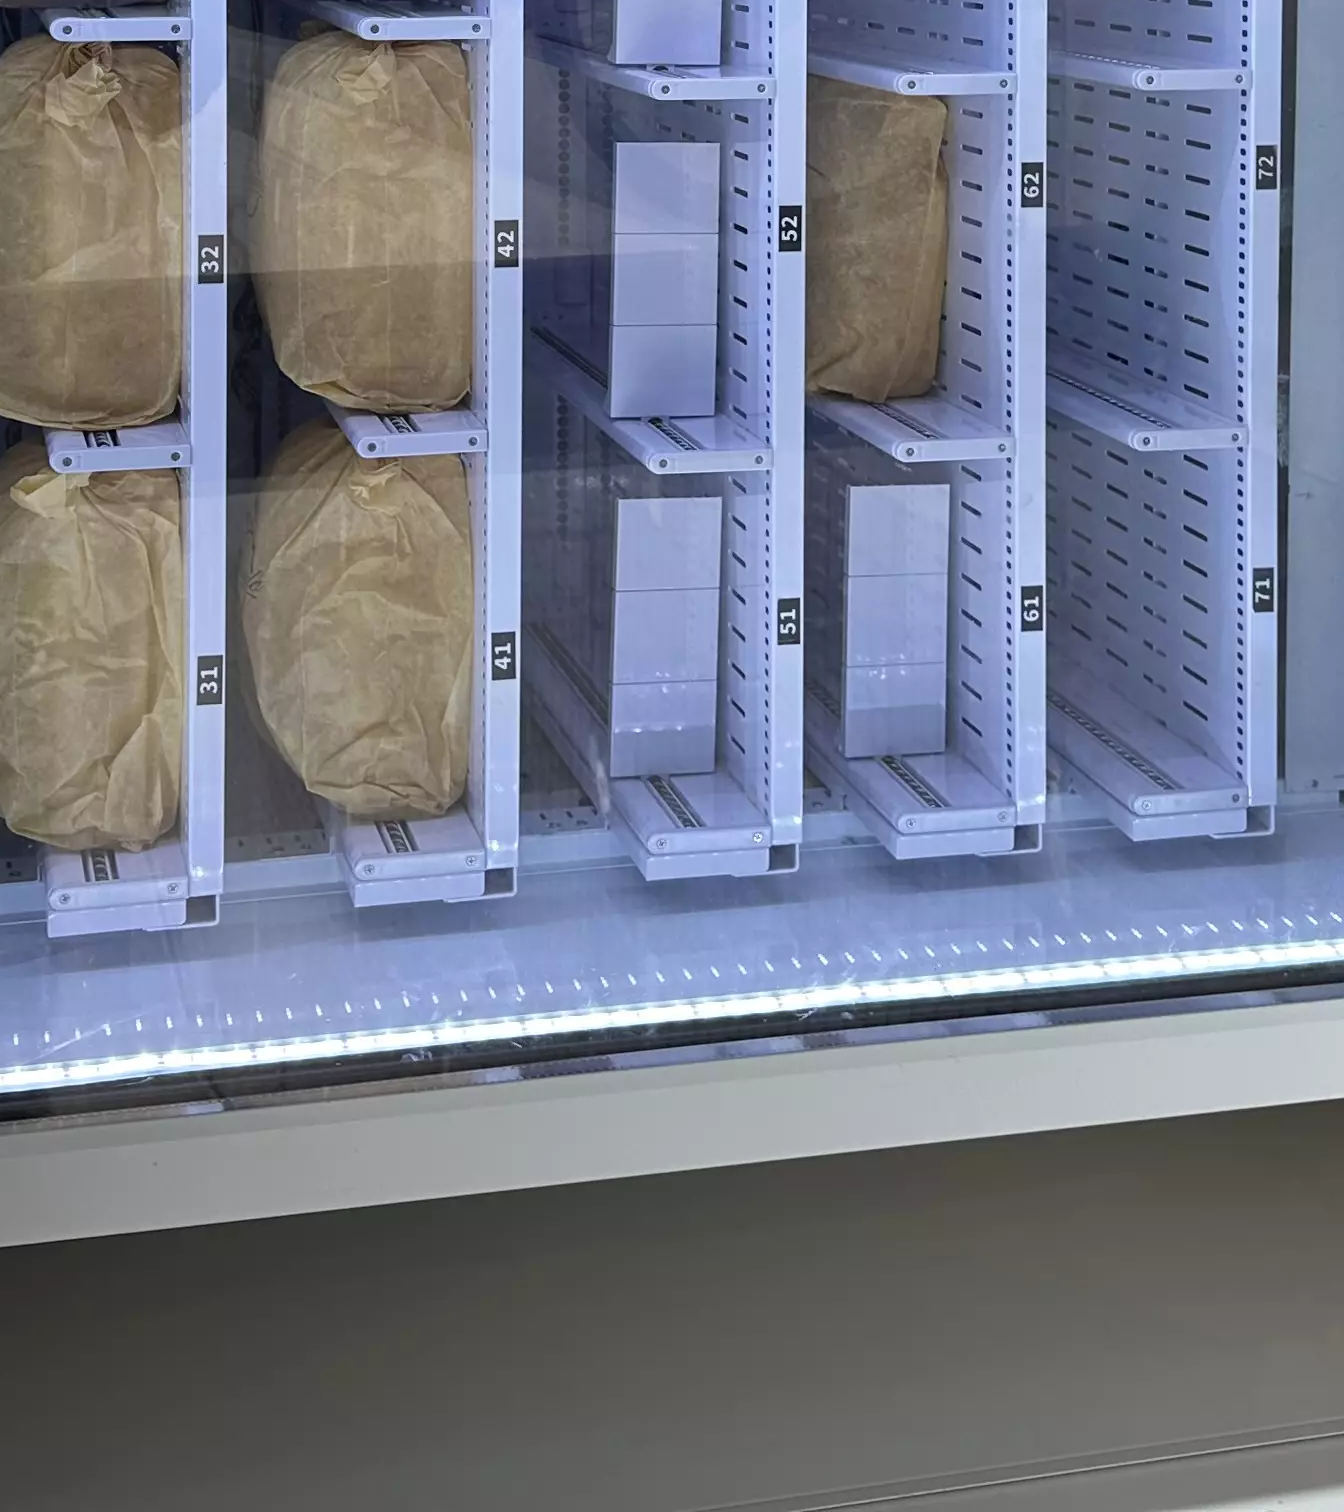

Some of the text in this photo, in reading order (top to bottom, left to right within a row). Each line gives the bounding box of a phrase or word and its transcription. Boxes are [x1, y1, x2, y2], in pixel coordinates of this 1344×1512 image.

[1259, 156, 1273, 179] 72
[1024, 173, 1039, 197] 62
[782, 216, 797, 241] 52
[498, 231, 514, 257] 42
[201, 247, 219, 272] 32
[1255, 579, 1270, 602] 71
[780, 609, 796, 634] 51
[1024, 597, 1039, 621] 61
[495, 643, 511, 669] 41
[200, 667, 217, 693] 31
